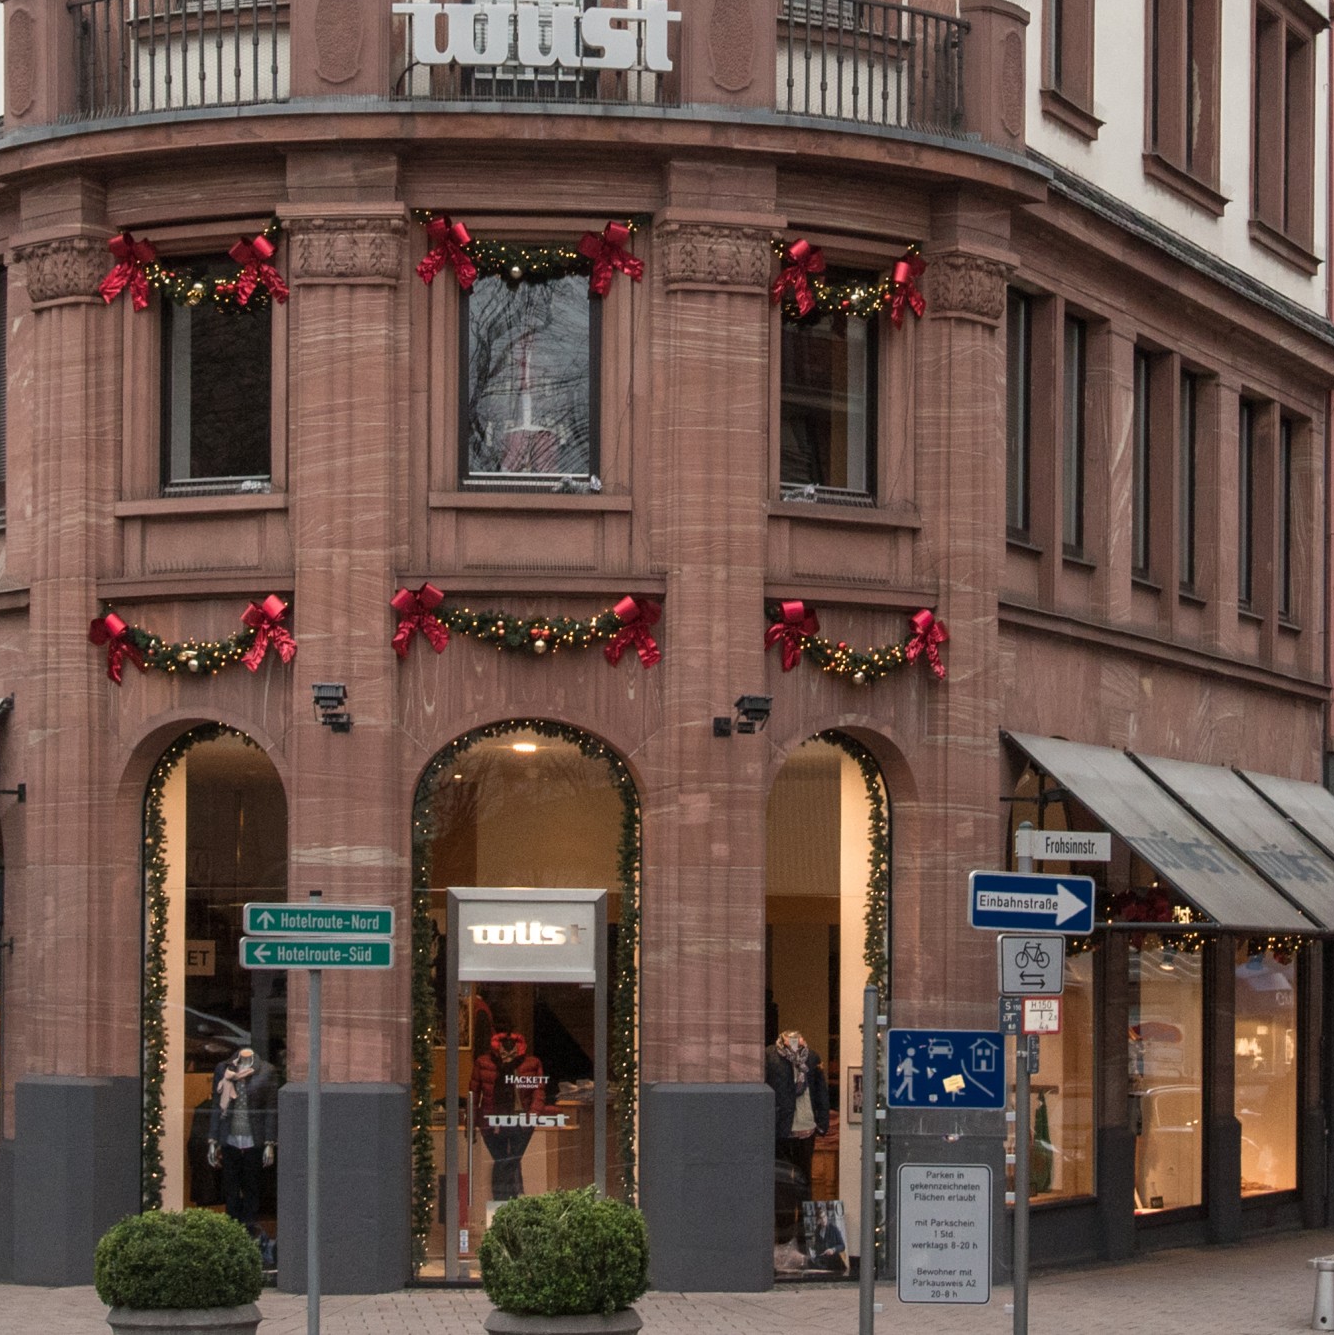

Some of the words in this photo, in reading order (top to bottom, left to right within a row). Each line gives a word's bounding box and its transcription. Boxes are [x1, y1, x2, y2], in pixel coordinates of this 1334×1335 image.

[1045, 836, 1098, 855] Frohsinnstr.
[979, 894, 1058, 911] Einbahnstraße
[280, 912, 380, 931] Hotelroute-Nord
[276, 945, 373, 963] Hotelroute-Süd
[505, 1074, 550, 1084] HACKETT
[483, 1113, 570, 1127] wüst
[926, 1171, 954, 1179] Parken
[957, 1171, 964, 1179] in
[910, 1183, 980, 1192] gekennzeichneten
[914, 1193, 945, 1202] Flächen
[947, 1193, 976, 1202] erlaubt
[915, 1219, 927, 1227] mit
[930, 1219, 975, 1227] Parkschein
[940, 1230, 955, 1238] Std.
[911, 1242, 948, 1251] werktags
[916, 1268, 956, 1276] Bewohner
[959, 1268, 972, 1276] mit
[912, 1279, 964, 1287] Parkausweis
